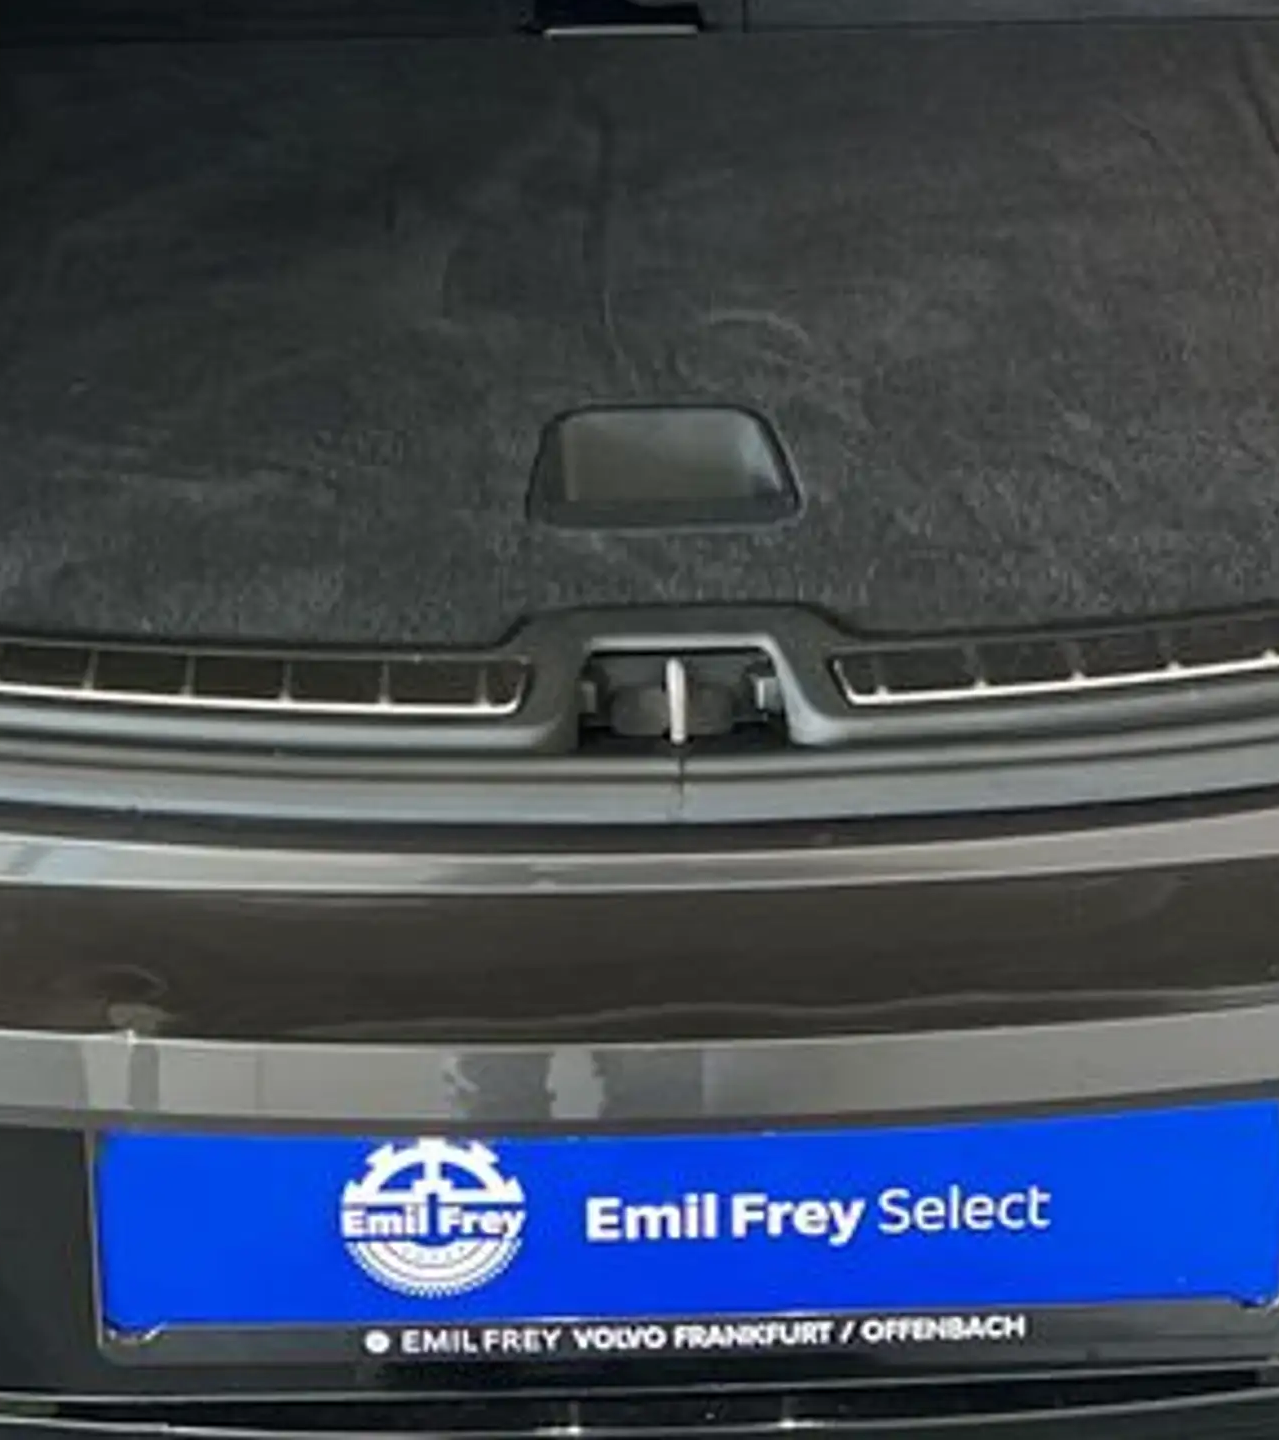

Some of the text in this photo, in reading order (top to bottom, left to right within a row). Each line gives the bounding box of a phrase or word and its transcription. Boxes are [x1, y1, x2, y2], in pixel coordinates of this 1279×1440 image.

[342, 1202, 526, 1240] Emil Frey
[585, 1183, 1052, 1247] Emil Frey Select
[400, 1328, 478, 1354] EMIL
[481, 1327, 563, 1353] FREY
[571, 1324, 667, 1351] VOLVO
[673, 1320, 835, 1349] FRANKFURT
[859, 1314, 1027, 1344] OFFENBACH
